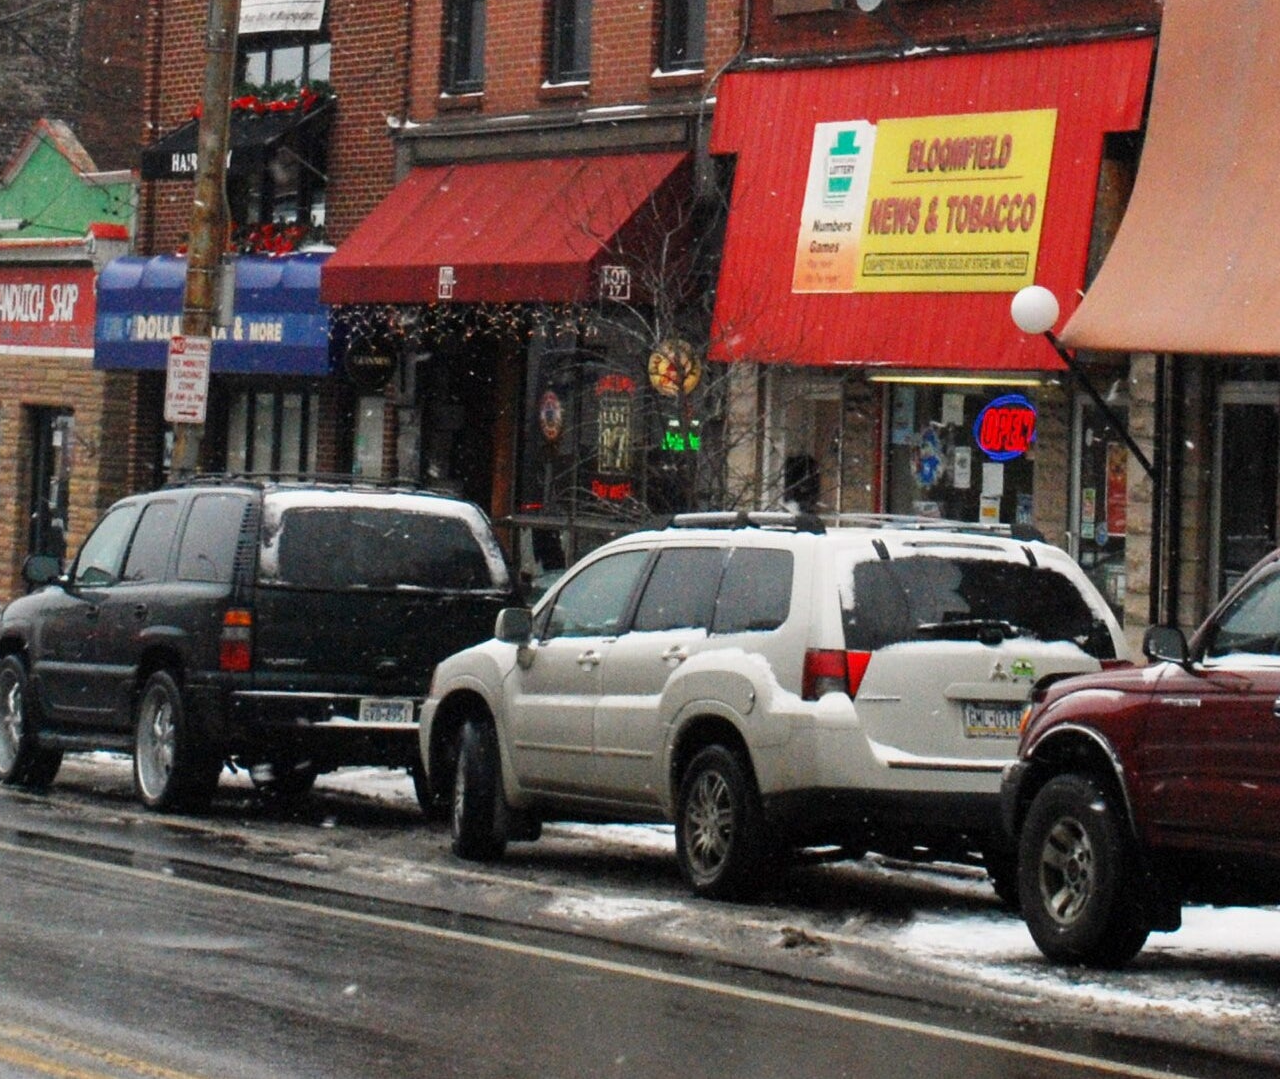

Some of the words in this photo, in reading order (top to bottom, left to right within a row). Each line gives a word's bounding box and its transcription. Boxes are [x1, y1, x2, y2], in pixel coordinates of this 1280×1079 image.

[907, 134, 1013, 173] BLOOMFIELD
[829, 165, 855, 176] LOTTERY
[868, 197, 922, 235] NEWS
[924, 195, 939, 235] &
[946, 193, 1037, 235] TOBACCO
[812, 220, 852, 233] Numbers
[809, 240, 840, 254] Games
[603, 269, 627, 285] LOT
[609, 285, 621, 296] 17
[49, 283, 79, 322] SHOP
[233, 316, 243, 340] &
[250, 323, 282, 342] MORE
[980, 408, 1036, 452] OPEN
